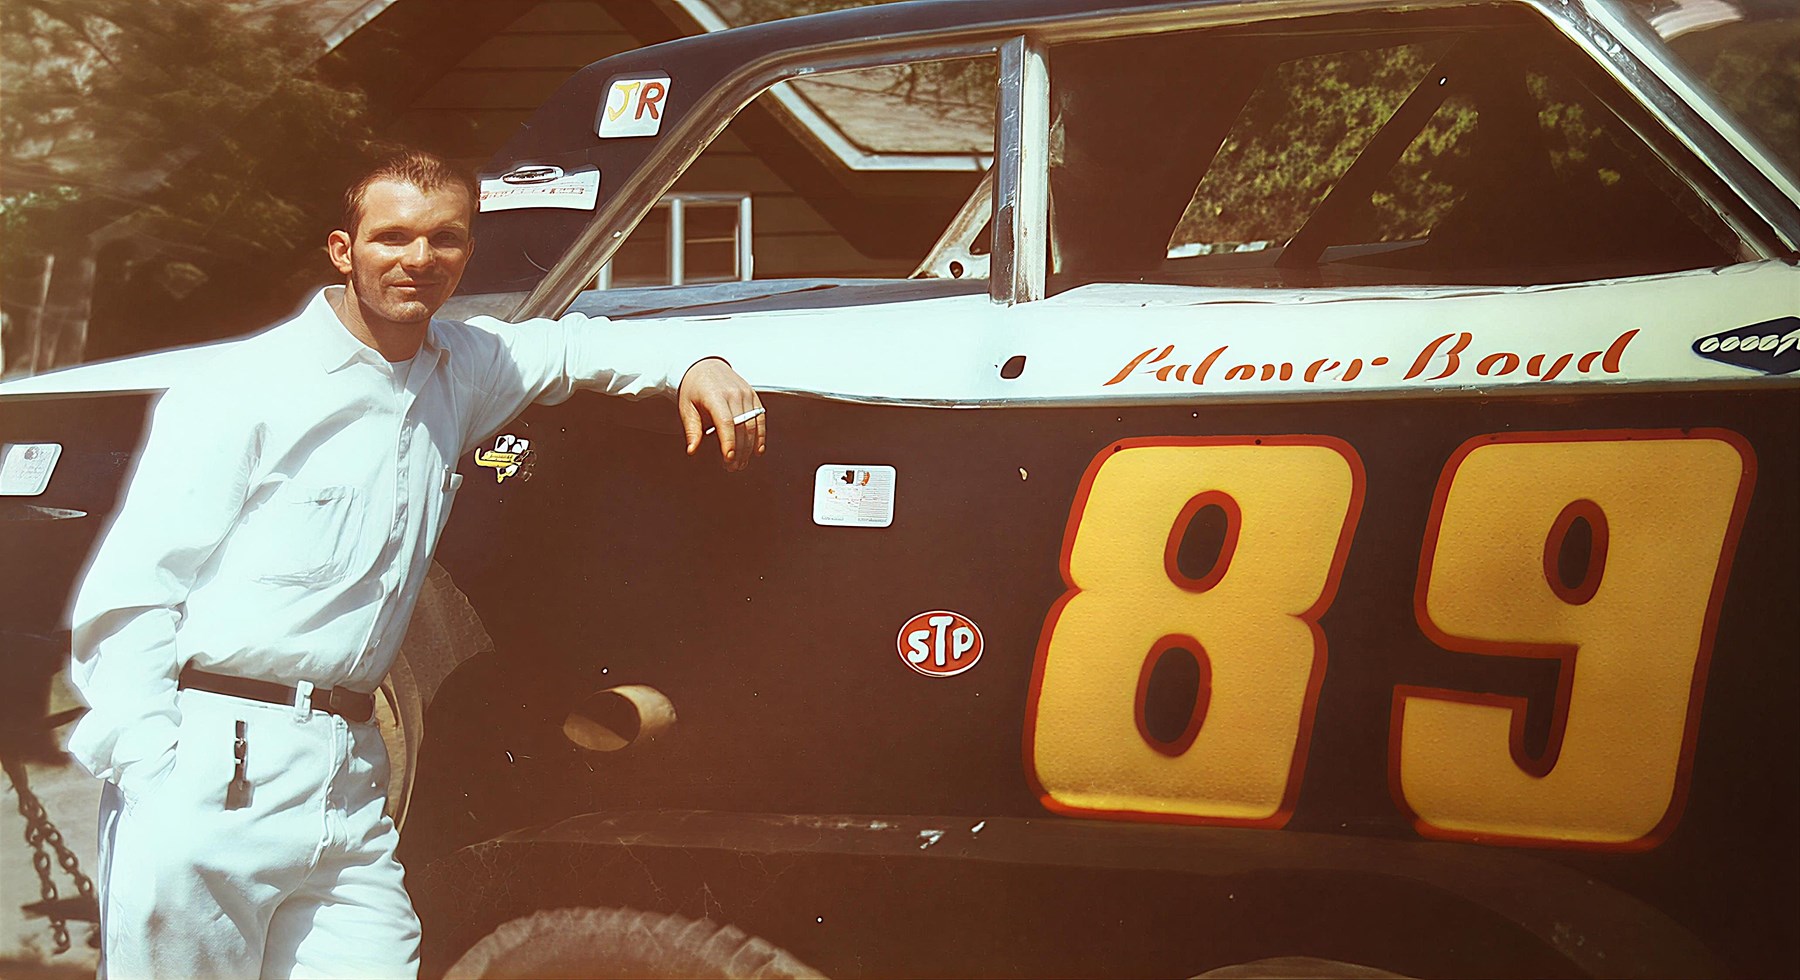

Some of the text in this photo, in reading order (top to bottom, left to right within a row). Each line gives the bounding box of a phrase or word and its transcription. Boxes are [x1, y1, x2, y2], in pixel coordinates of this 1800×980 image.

[607, 81, 665, 122] JR
[1402, 328, 1641, 382] Boyd
[906, 615, 975, 666] STP
[1021, 427, 1758, 851] 89
